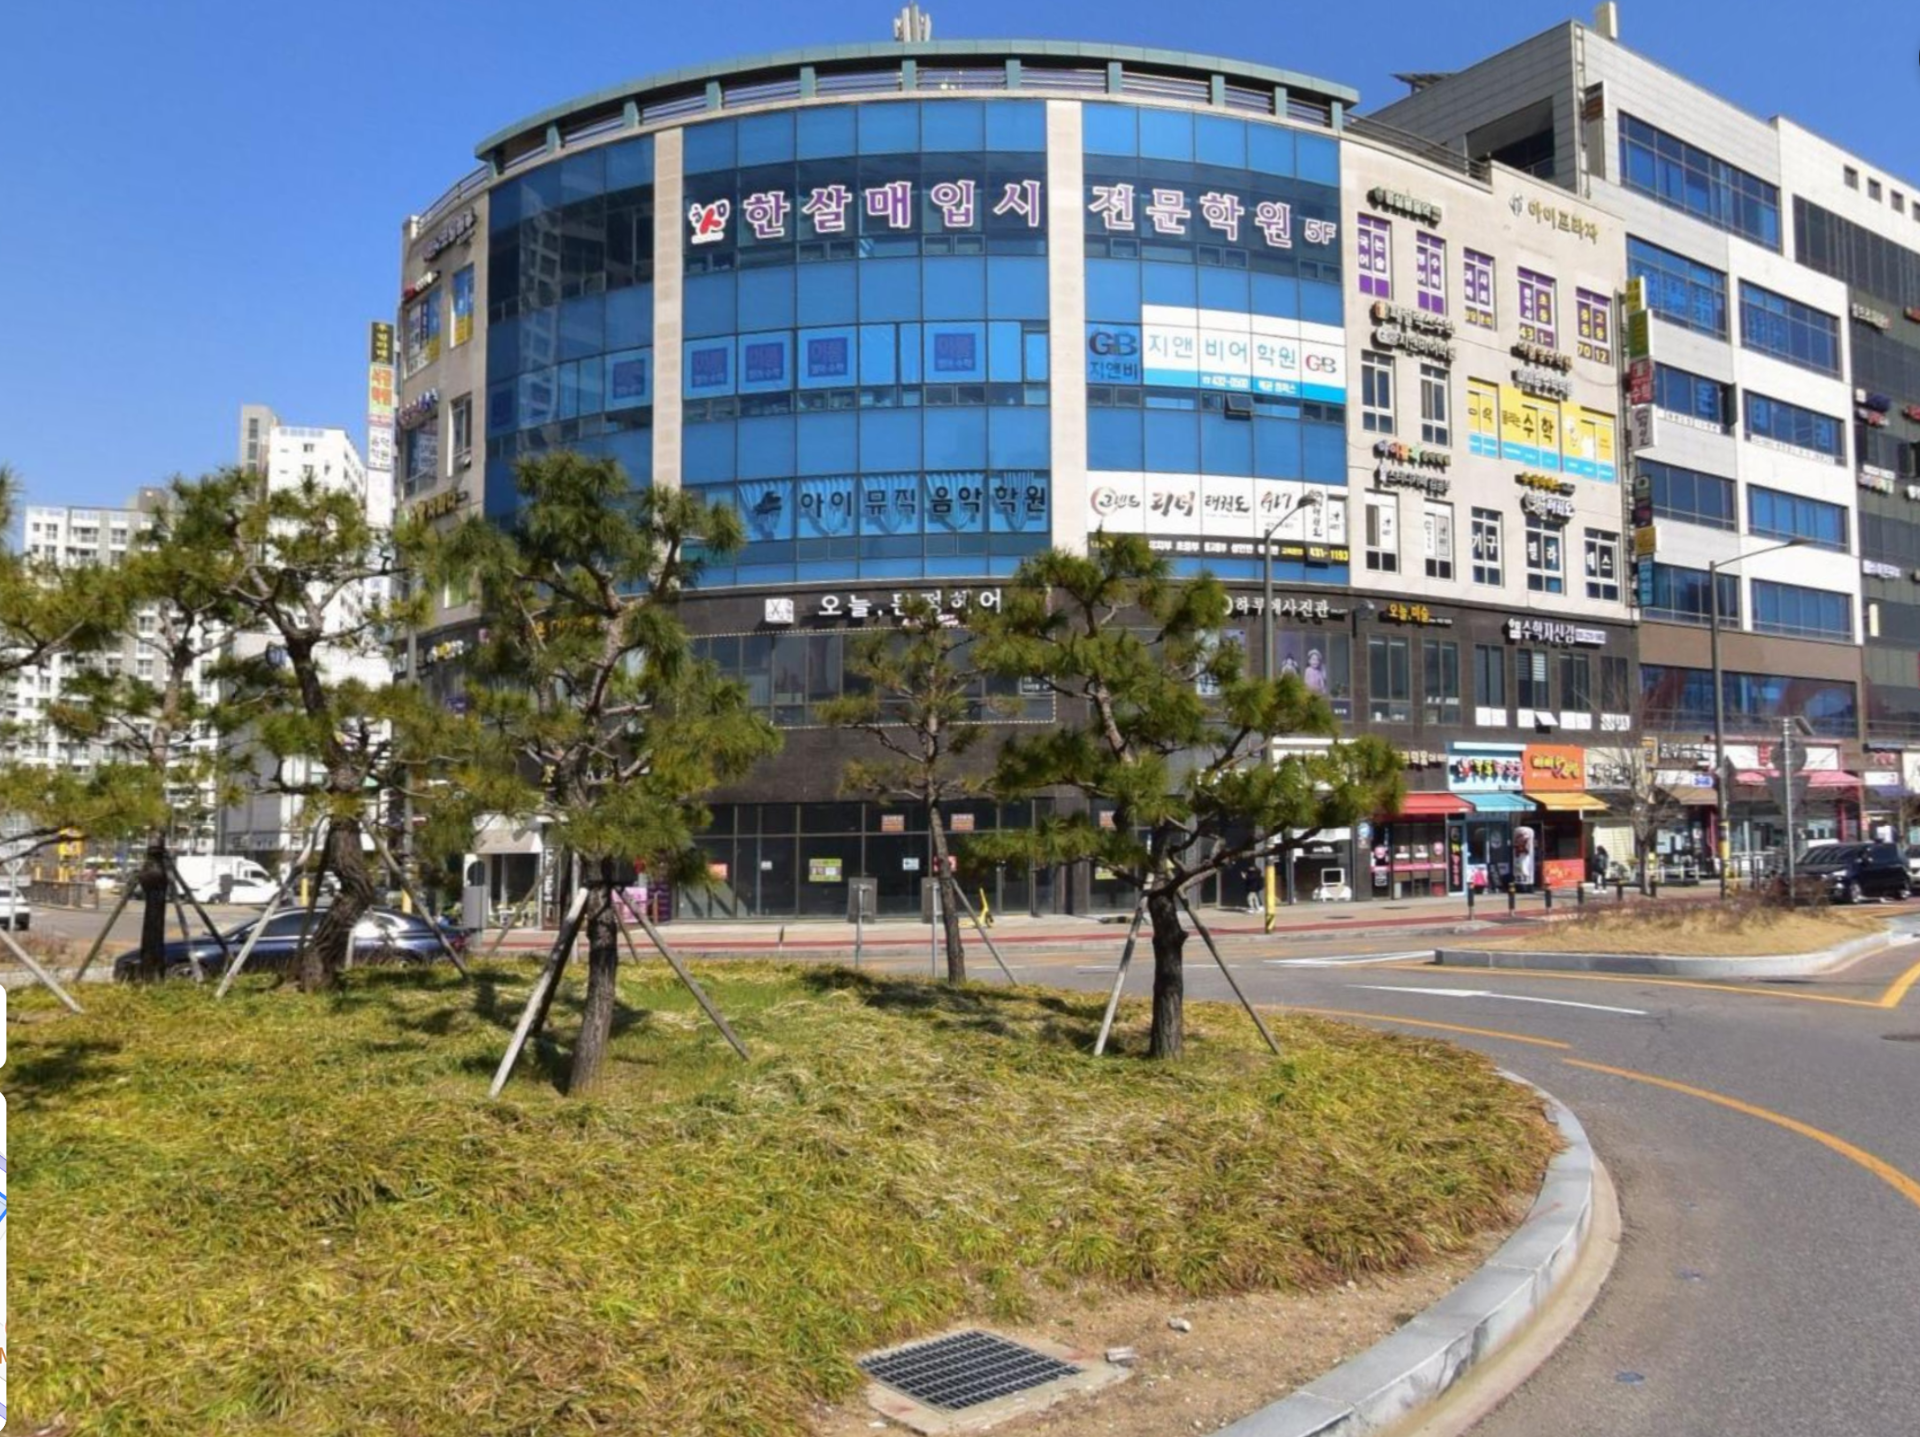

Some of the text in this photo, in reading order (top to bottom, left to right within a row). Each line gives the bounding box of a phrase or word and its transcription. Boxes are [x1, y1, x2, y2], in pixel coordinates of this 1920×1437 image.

[1089, 183, 1337, 248] 전문학원 5F
[1528, 200, 1599, 245] 아이프라자
[1089, 328, 1138, 356] GB
[1148, 333, 1338, 374] 지앤비어학원 GB
[1090, 360, 1139, 380] 지앤비
